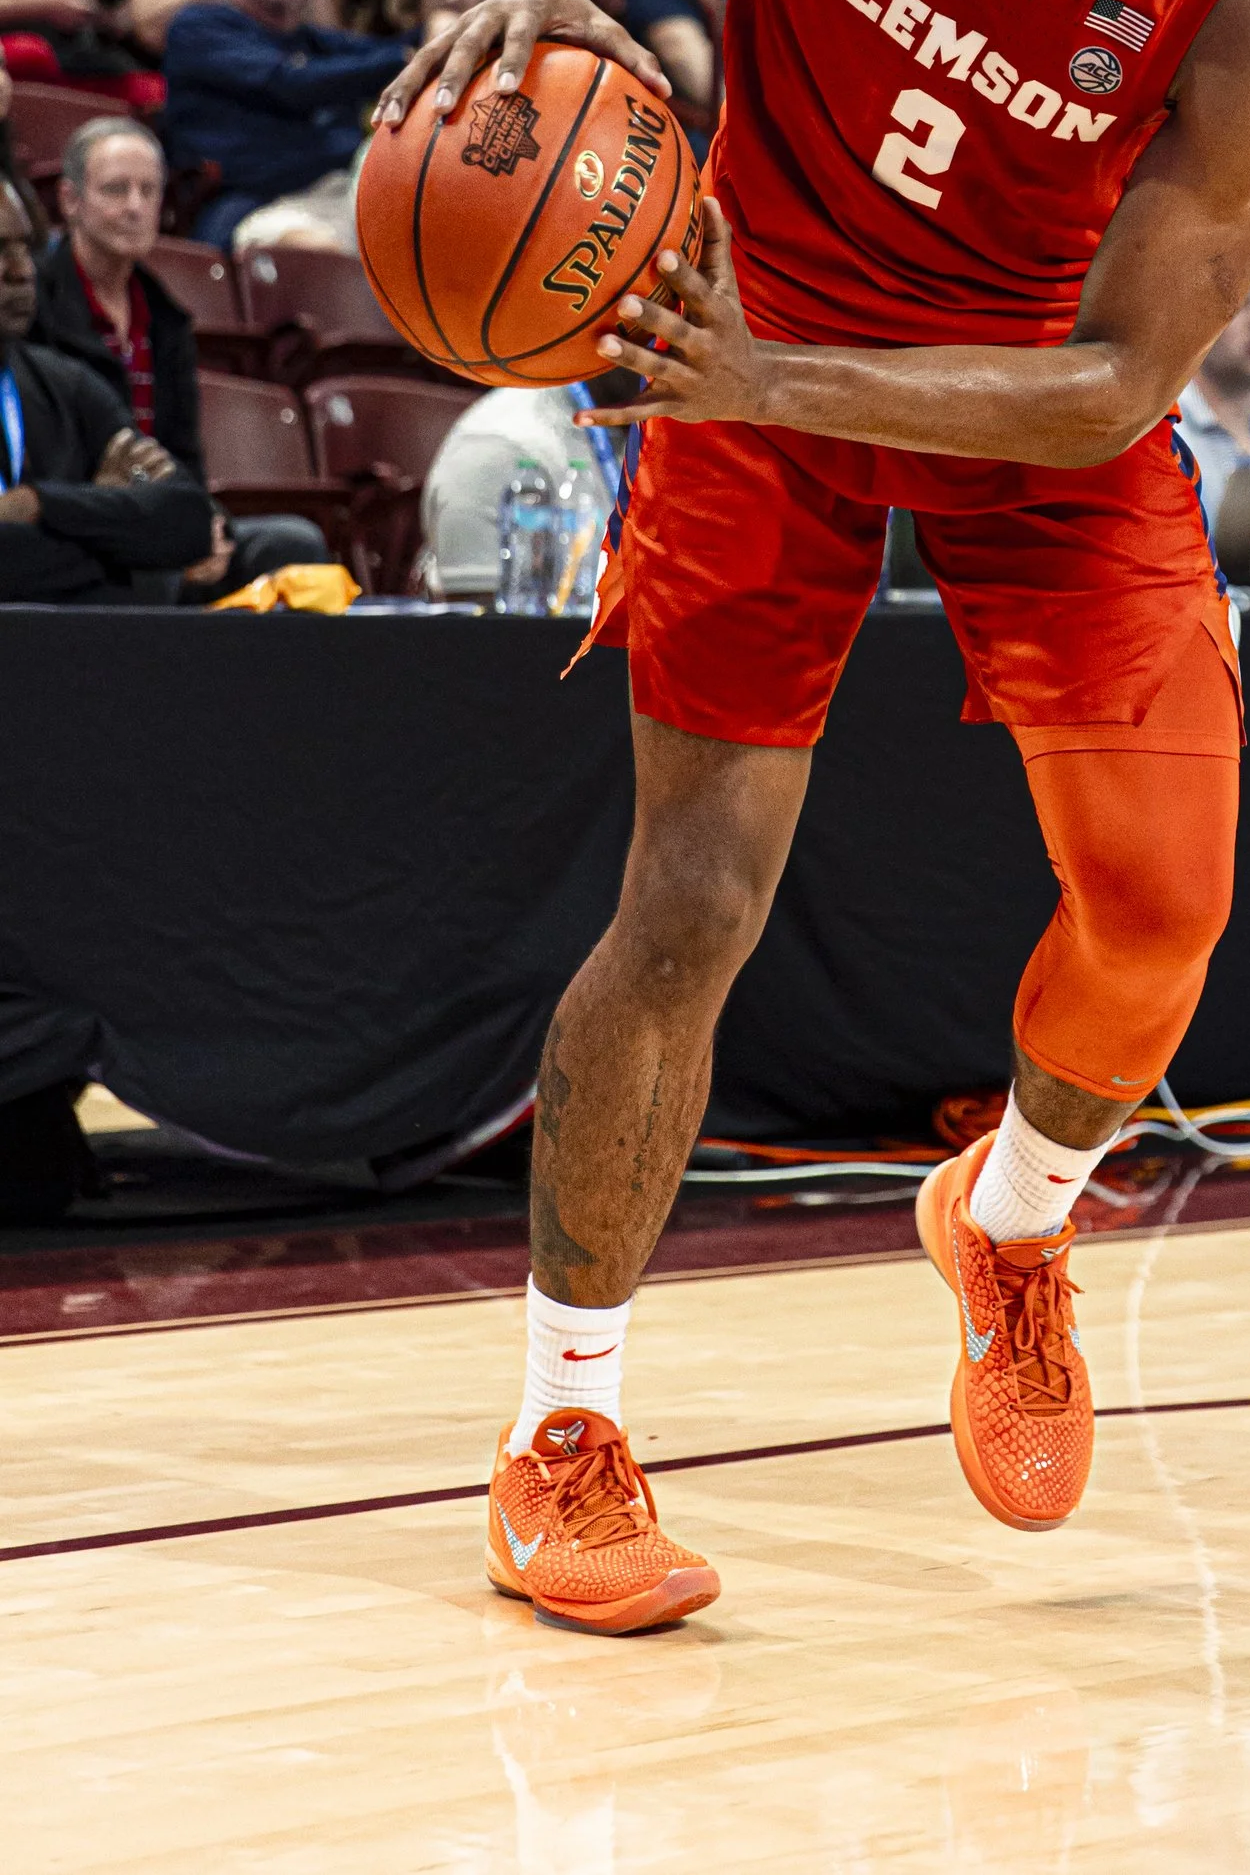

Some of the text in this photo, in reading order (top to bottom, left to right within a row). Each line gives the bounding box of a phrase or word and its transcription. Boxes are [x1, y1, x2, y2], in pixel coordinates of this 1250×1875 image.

[1075, 62, 1120, 85] ACC
[500, 112, 529, 159] Classic
[872, 88, 966, 210] 2
[542, 94, 668, 313] SPALDING
